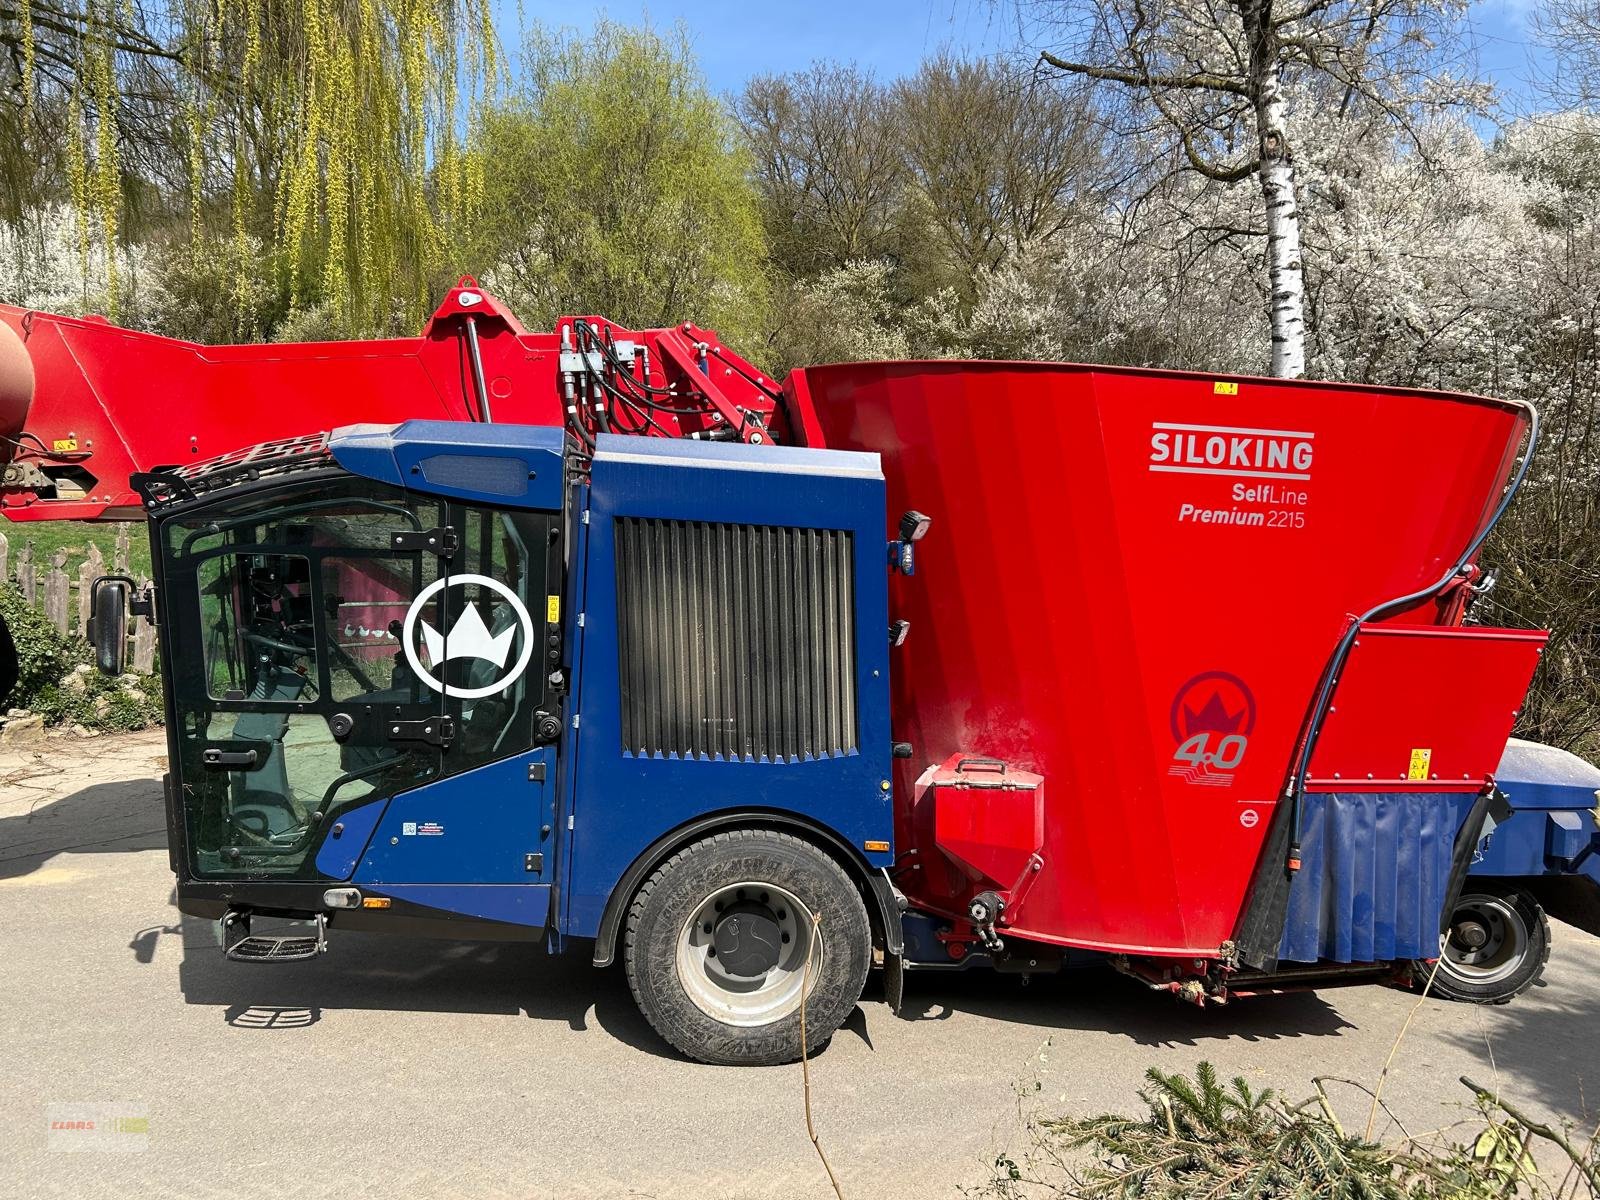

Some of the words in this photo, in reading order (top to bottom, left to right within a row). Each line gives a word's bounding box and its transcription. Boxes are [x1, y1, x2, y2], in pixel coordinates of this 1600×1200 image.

[1150, 432, 1313, 470] SILOKING
[1232, 483, 1308, 505] SelfLine
[1179, 504, 1264, 526] Premium
[1267, 510, 1305, 528] 2215
[1173, 733, 1248, 769] 4.0
